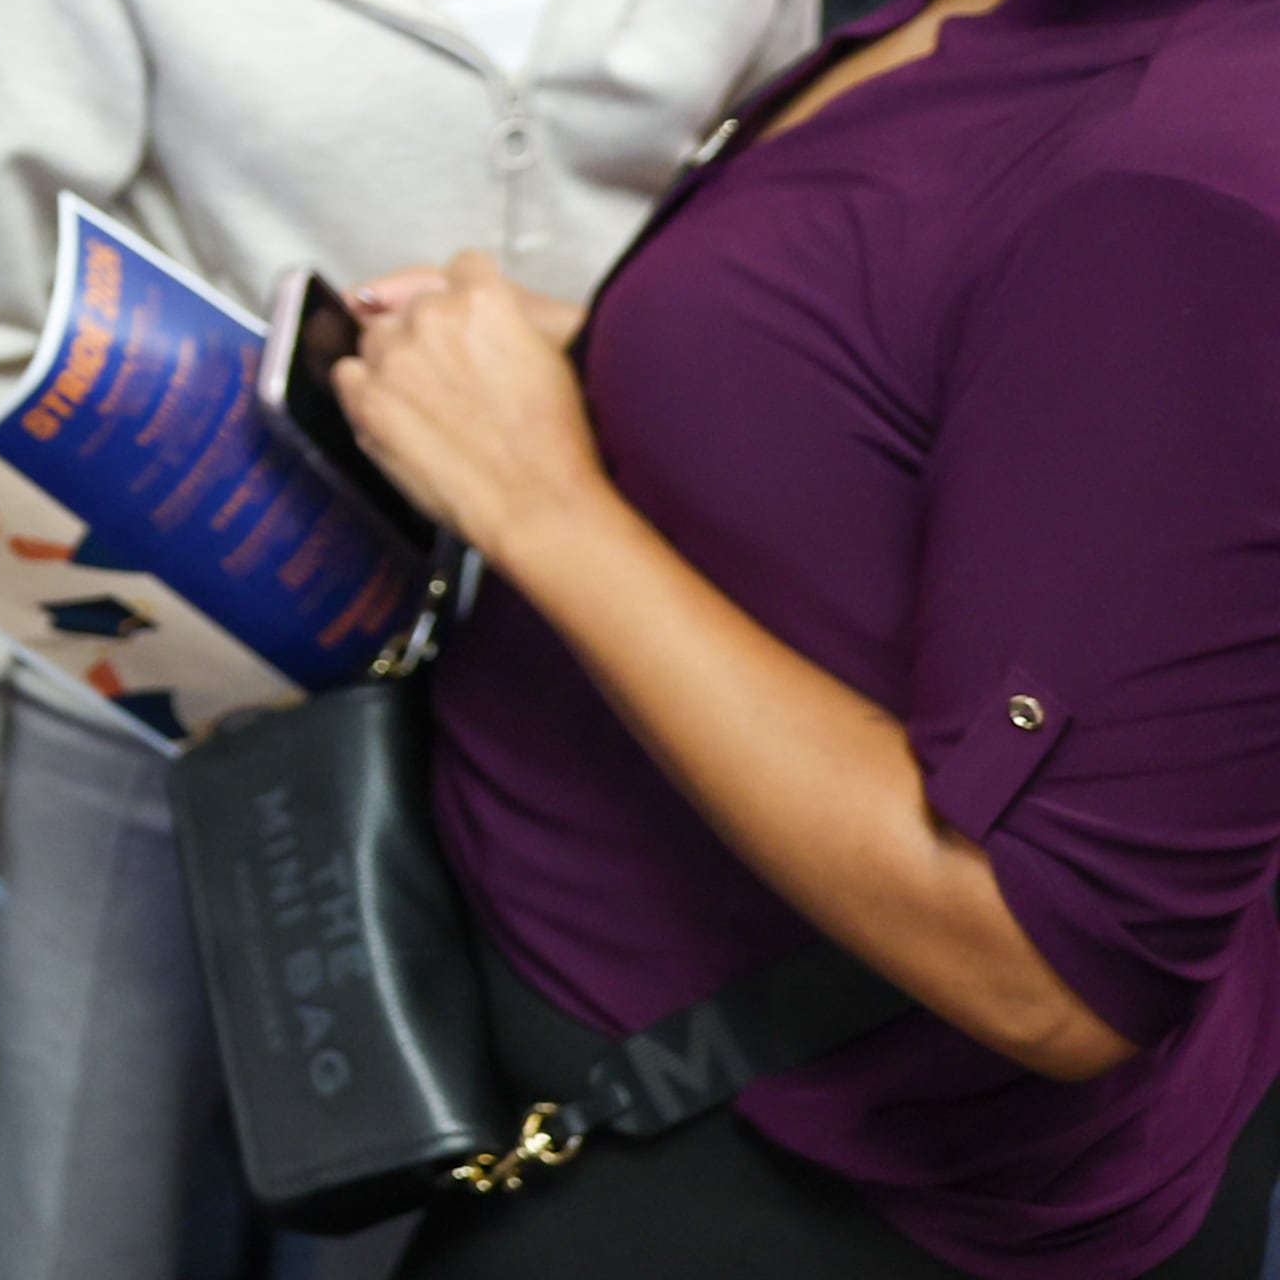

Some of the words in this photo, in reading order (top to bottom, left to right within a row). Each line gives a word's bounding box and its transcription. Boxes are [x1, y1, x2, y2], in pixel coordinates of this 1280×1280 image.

[254, 789, 309, 926] MINI
[286, 948, 352, 1098] BAG
[312, 850, 372, 987] THE
